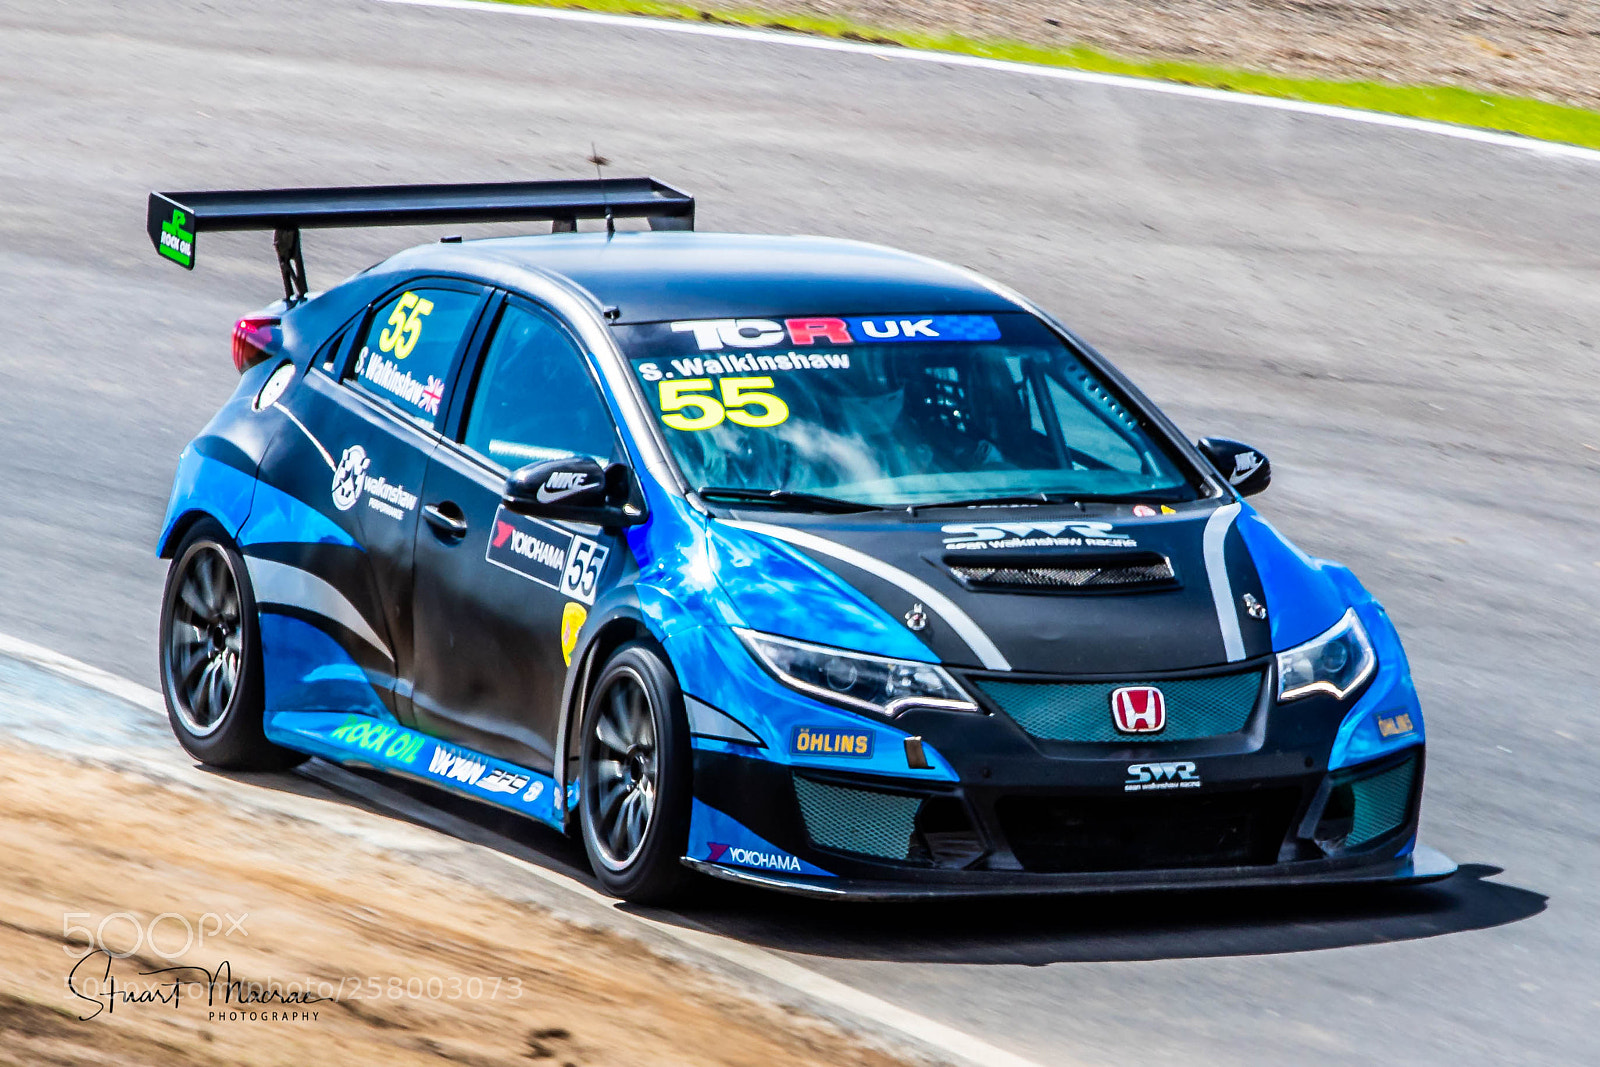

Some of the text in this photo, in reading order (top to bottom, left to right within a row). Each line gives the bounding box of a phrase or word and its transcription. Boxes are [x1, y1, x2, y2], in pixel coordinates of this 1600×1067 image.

[161, 231, 191, 256] ROCK OIL
[379, 291, 434, 359] 55
[671, 318, 940, 350] TCR UK
[672, 351, 850, 377] Walkinshaw
[658, 376, 790, 431] 55
[546, 472, 588, 489] NIKE
[941, 521, 1131, 544] SWR
[510, 528, 605, 597] YOKOHAMA 55
[331, 713, 397, 752] ROCK
[385, 733, 425, 764] OIL
[797, 728, 868, 754] ÖHLINS
[1125, 761, 1199, 784] SWR
[729, 847, 801, 871] YOKOHAMA
